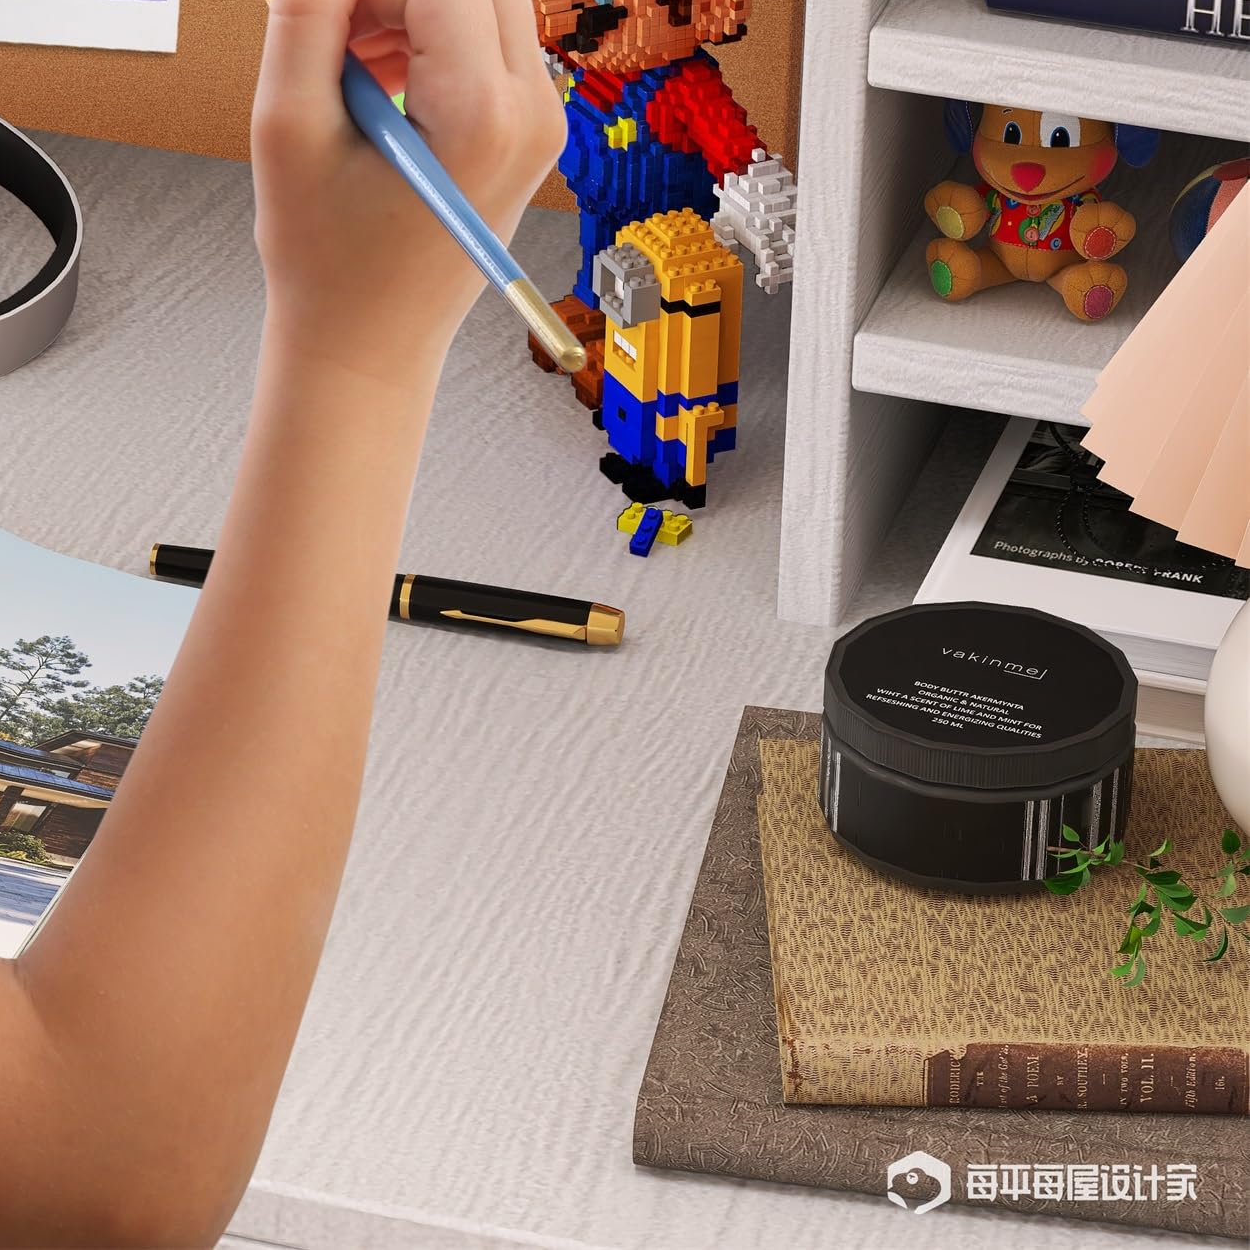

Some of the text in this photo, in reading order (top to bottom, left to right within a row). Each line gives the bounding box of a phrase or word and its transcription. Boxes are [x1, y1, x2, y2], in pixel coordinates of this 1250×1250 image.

[993, 541, 1073, 562] Photographs
[876, 688, 901, 698] WIHT
[909, 695, 938, 707] SCENT
[953, 706, 975, 716] LIME
[976, 711, 997, 720] AND
[997, 716, 1023, 726] MINT
[1023, 722, 1042, 731] FOR
[914, 680, 1025, 711] BODY BUTTR AKERMYNTA
[917, 690, 959, 704] ORGANIC
[969, 702, 1010, 715] NATURAL
[865, 693, 1042, 739] REFSESHING AND ENERGIZING QUALITIES
[931, 717, 964, 729] 250 ML
